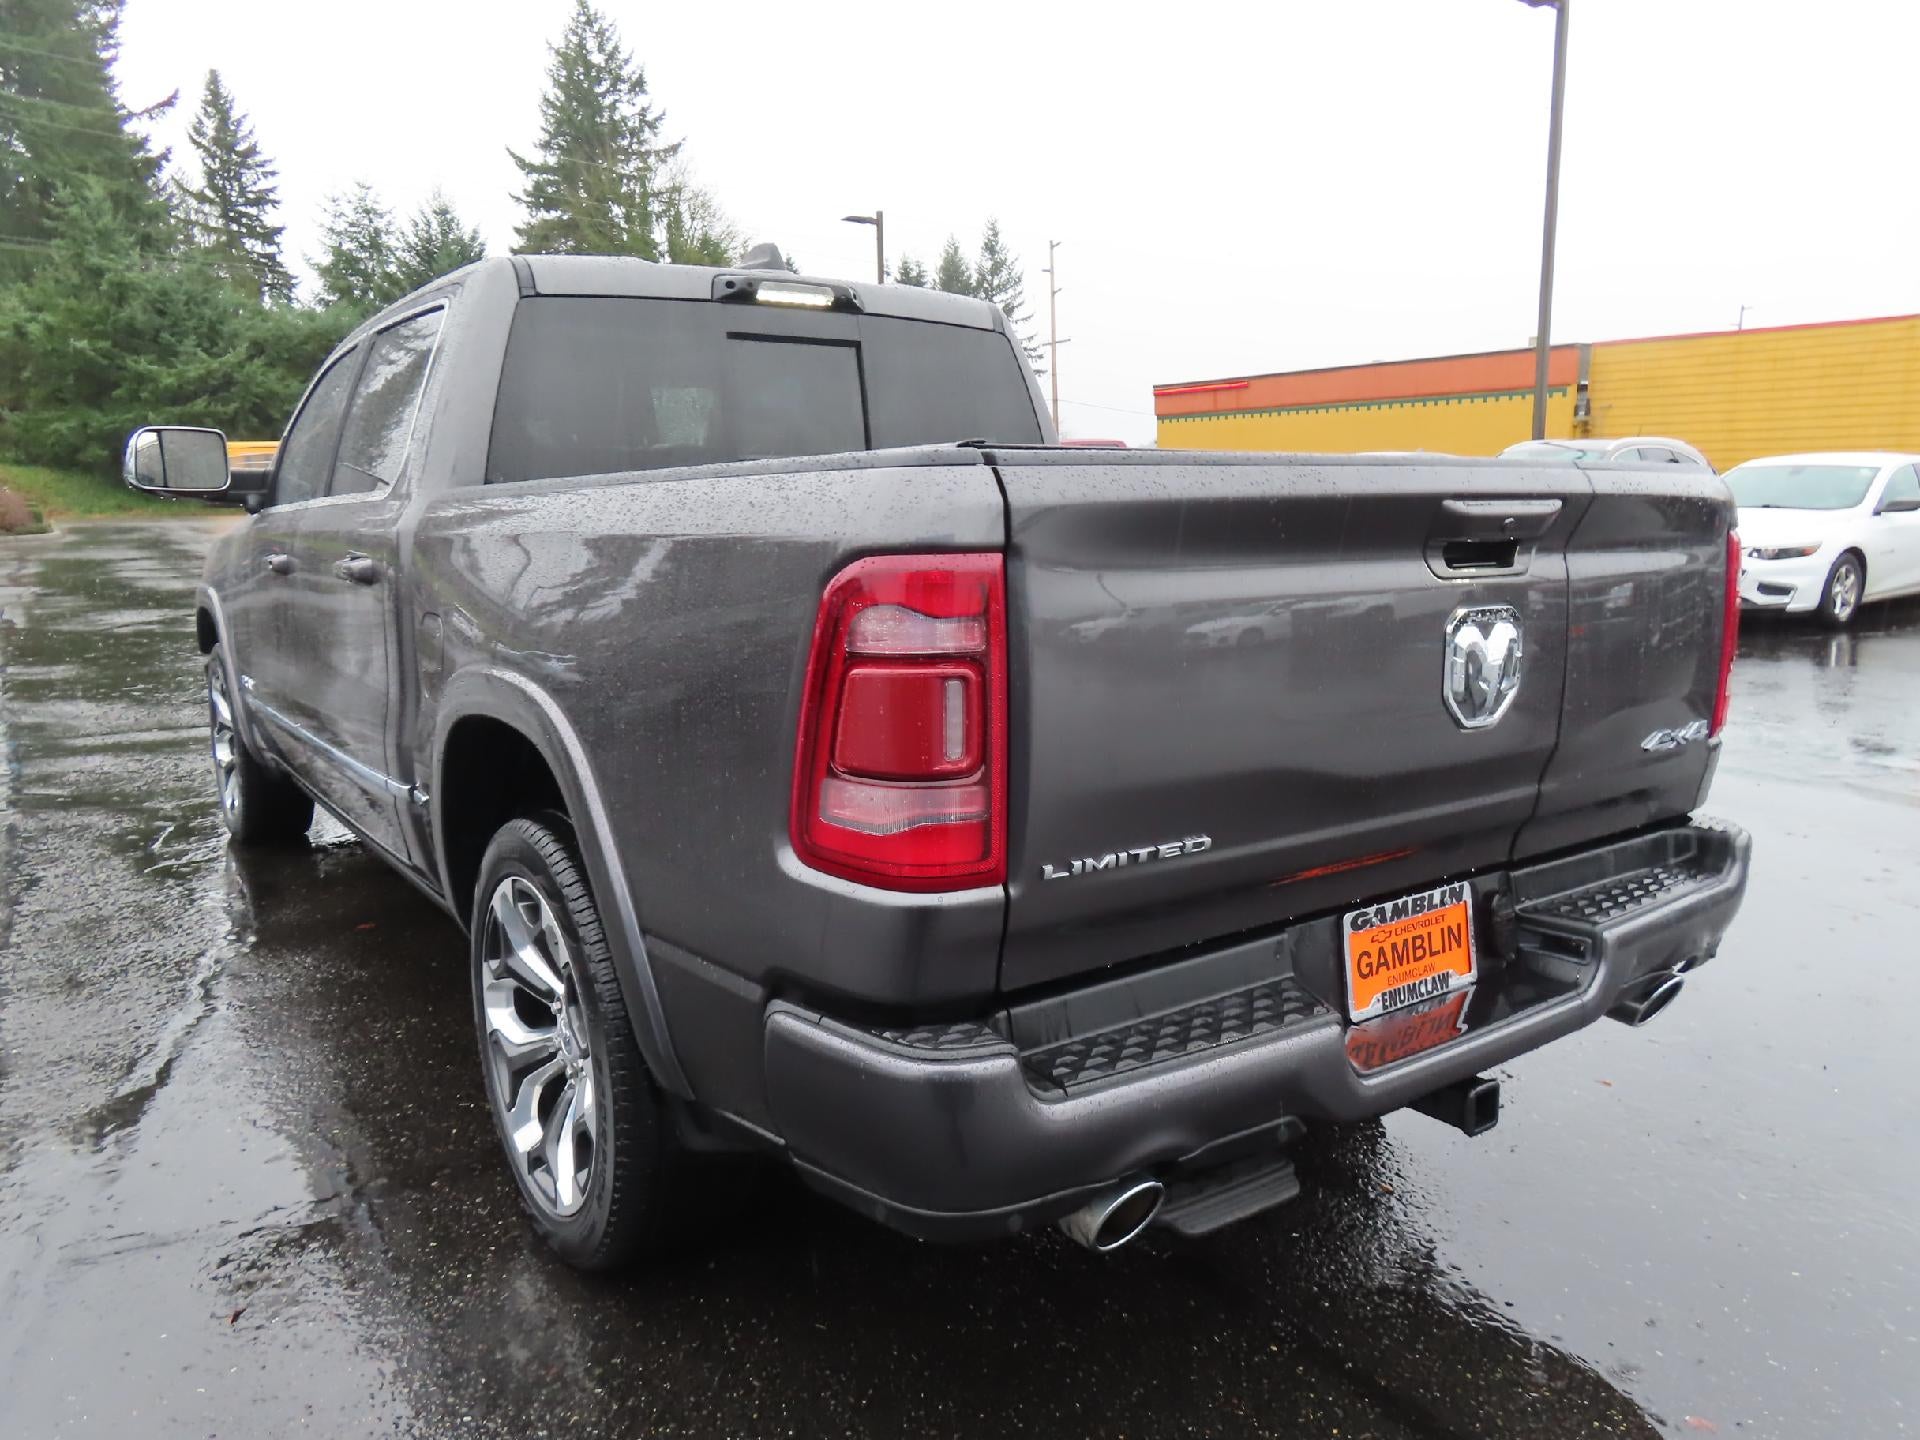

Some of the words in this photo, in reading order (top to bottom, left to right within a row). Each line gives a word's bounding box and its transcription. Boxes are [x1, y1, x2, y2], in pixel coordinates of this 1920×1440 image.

[1041, 834, 1213, 881] LIMITED
[1350, 884, 1464, 932] GAMBLIN
[1394, 914, 1447, 936] CHEVROLET
[1356, 922, 1462, 980] GAMBLIN
[1381, 970, 1450, 1011] ENUMCLAW
[1387, 962, 1436, 986] ENUMCLAW
